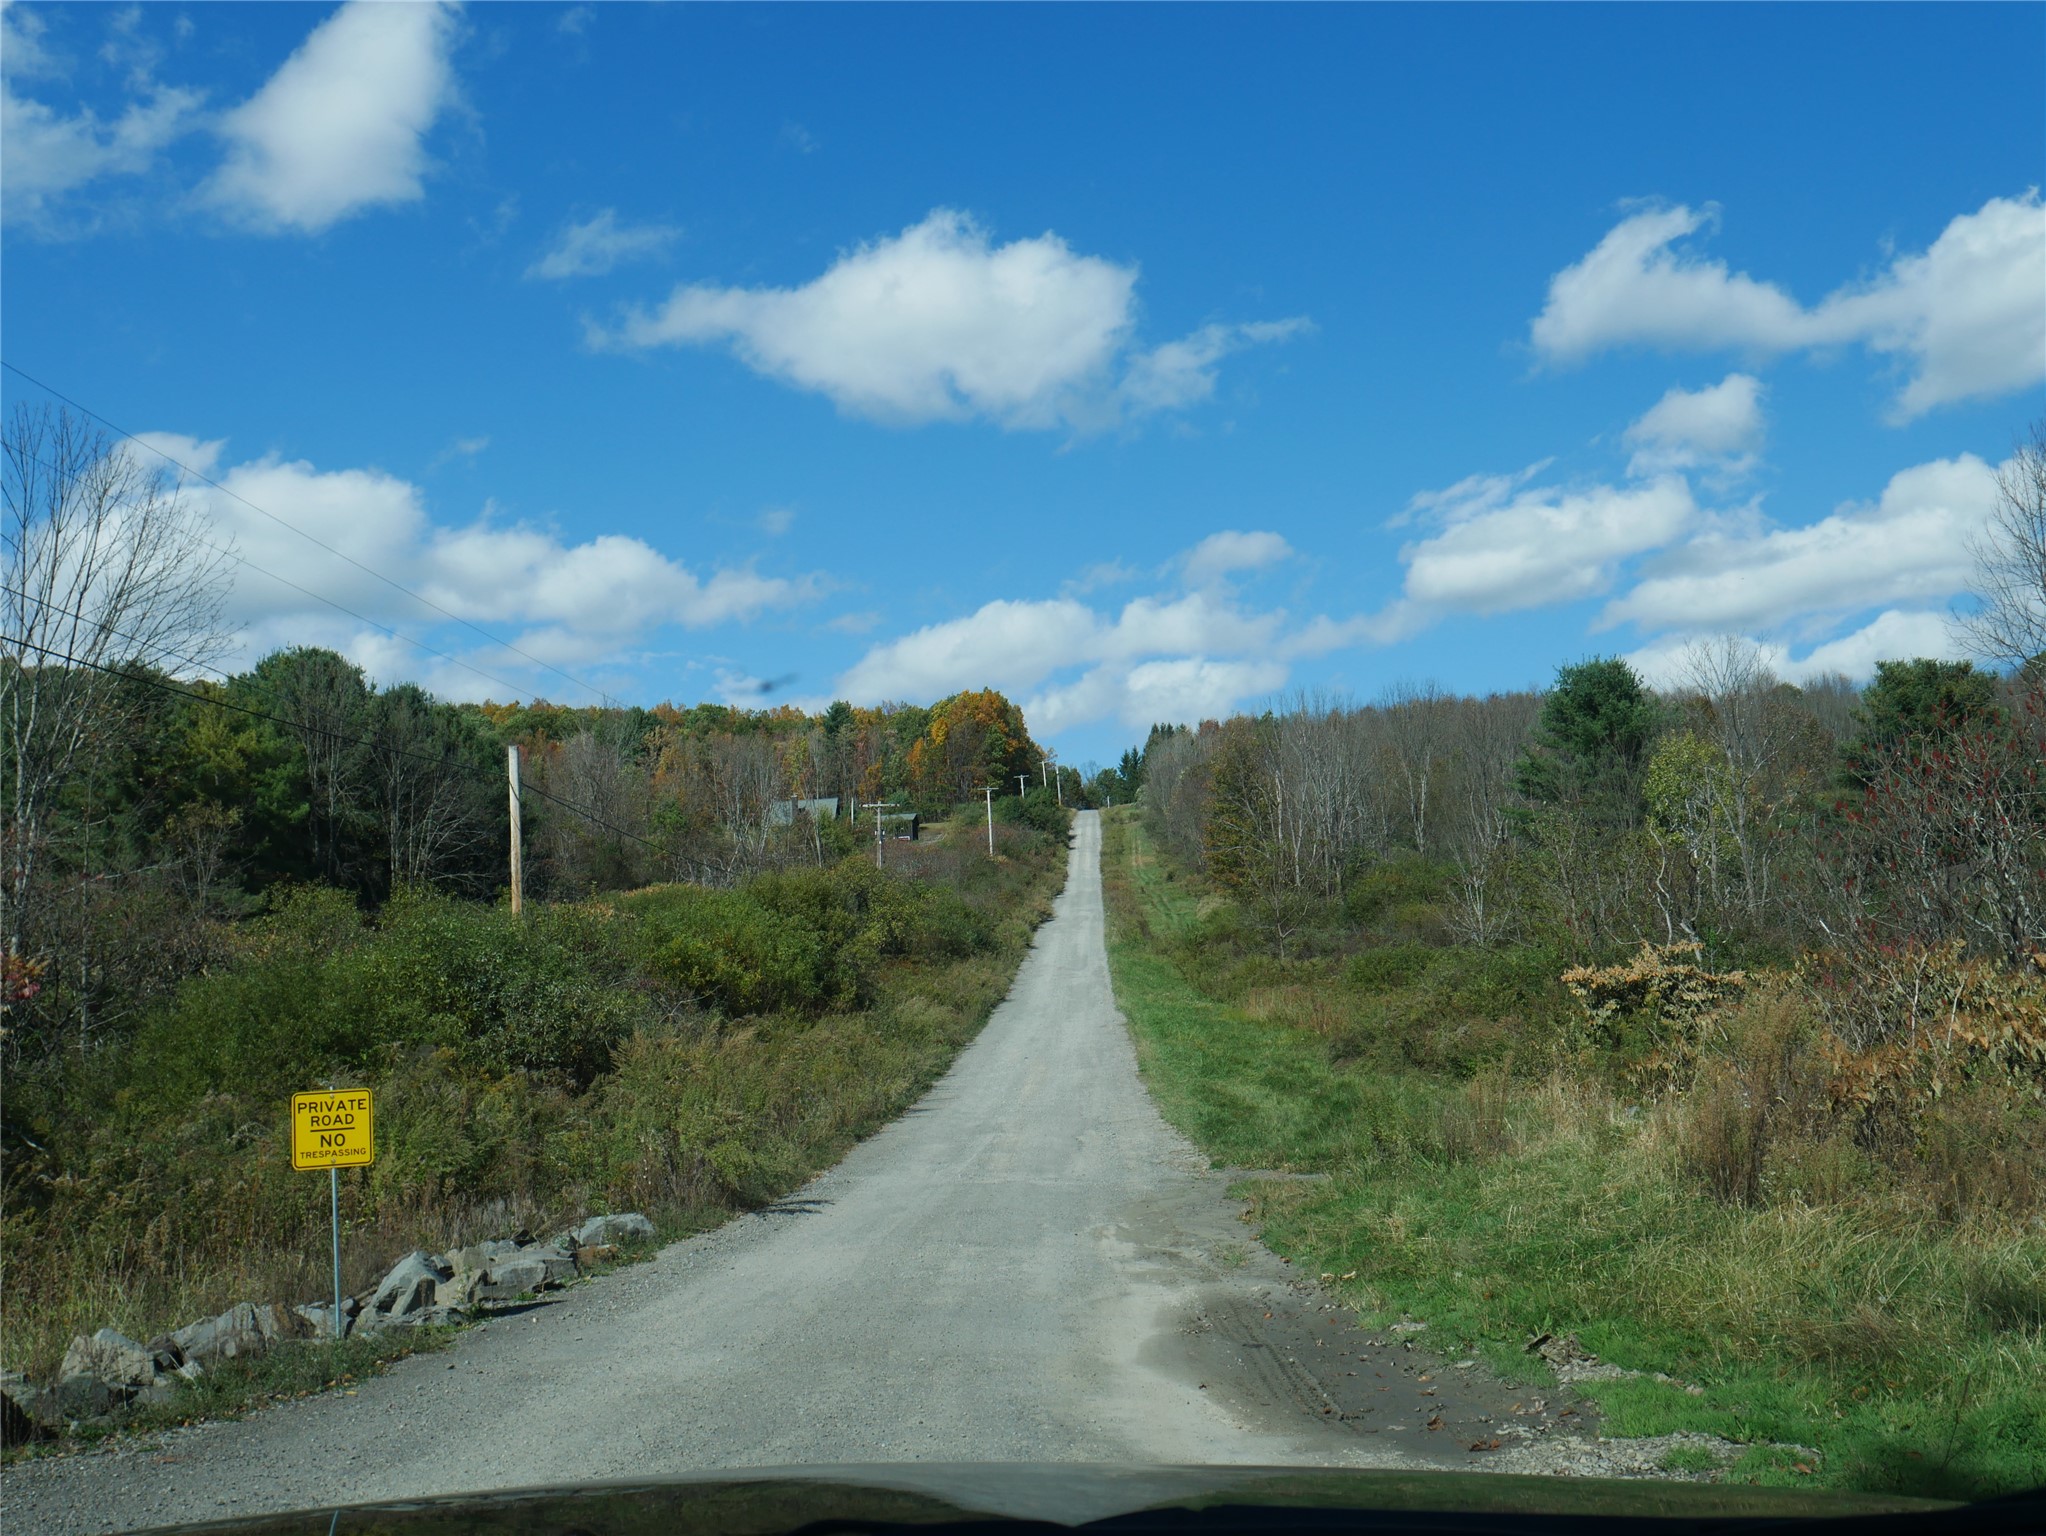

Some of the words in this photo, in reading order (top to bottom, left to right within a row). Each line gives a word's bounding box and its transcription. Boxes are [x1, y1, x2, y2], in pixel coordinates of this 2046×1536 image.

[297, 1098, 367, 1114] PRIVATE
[310, 1113, 355, 1127] ROAD
[320, 1133, 346, 1148] NO
[300, 1147, 367, 1159] TRESPASSING
